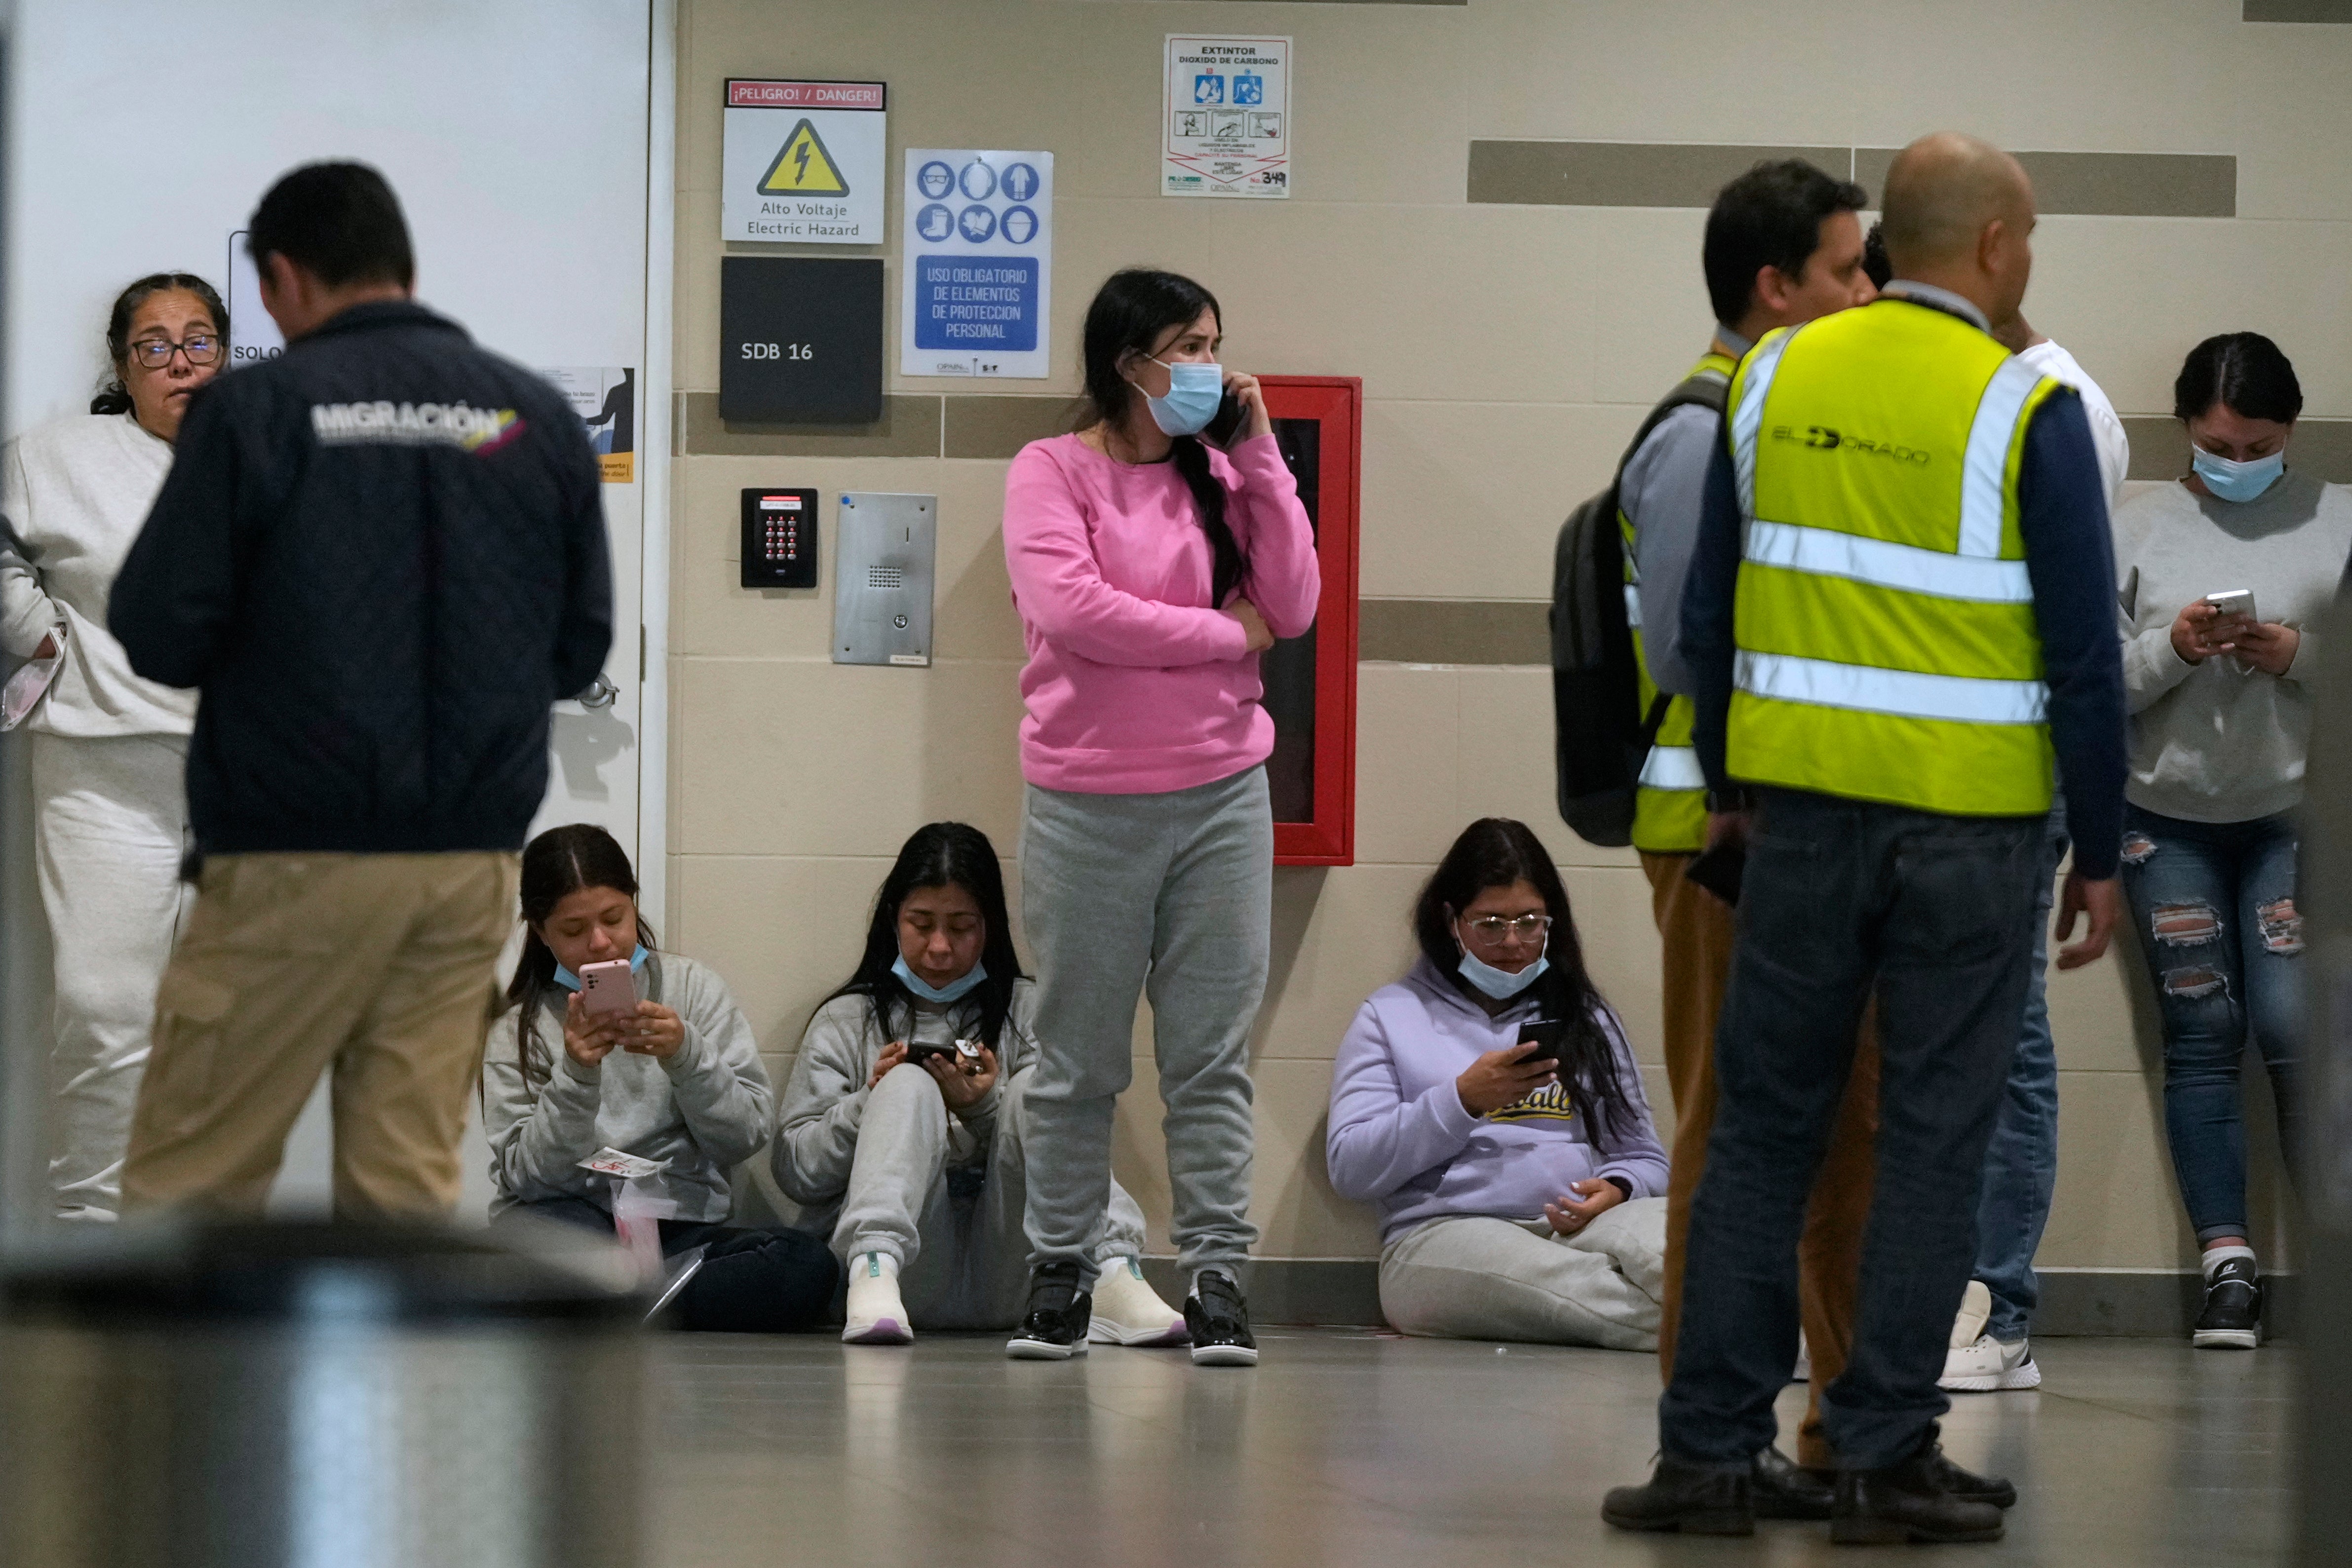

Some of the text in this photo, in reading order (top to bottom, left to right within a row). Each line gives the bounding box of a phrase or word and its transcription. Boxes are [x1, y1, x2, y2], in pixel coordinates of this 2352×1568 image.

[1201, 46, 1255, 55] EXTINTOR
[816, 90, 876, 102] DANGER!
[761, 202, 848, 218] Alto Voltaje
[748, 222, 859, 236] Electric Hazard
[927, 268, 1027, 284] USO OBLIGATORIO
[933, 286, 1021, 302] DE ELEMENTOS
[932, 305, 1021, 320] DE PROTECCION
[946, 323, 1006, 338] PERSONAL
[234, 346, 282, 360] SOLO
[741, 343, 813, 359] SDB 16
[311, 400, 501, 438] MIGRACIÓN
